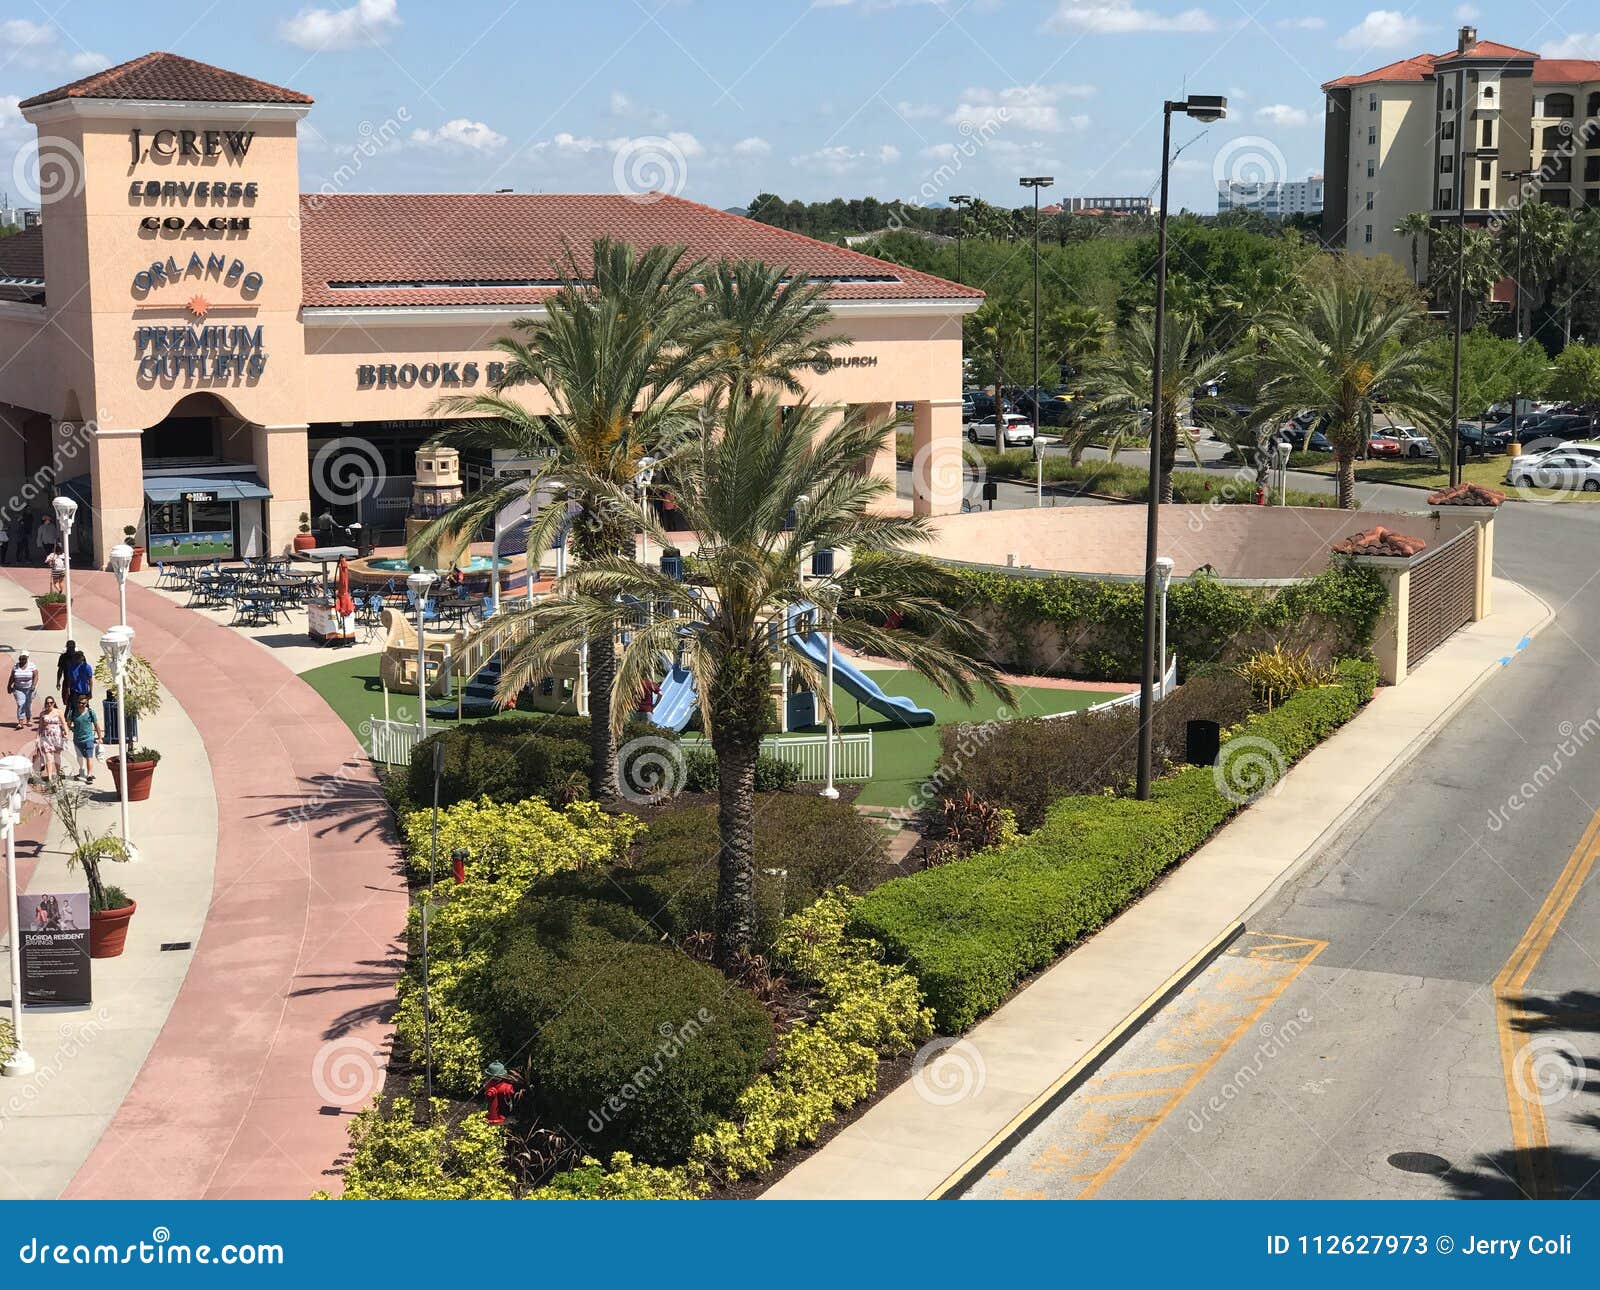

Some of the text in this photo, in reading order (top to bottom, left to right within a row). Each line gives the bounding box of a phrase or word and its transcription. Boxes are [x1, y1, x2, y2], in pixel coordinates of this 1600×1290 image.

[130, 128, 256, 166] J.CREW
[130, 181, 258, 198] CONVERSE
[141, 216, 251, 230] COACH
[134, 251, 264, 290] ORLANDO
[136, 325, 265, 350] PREMIUM
[139, 353, 265, 379] OUTLETS
[358, 362, 479, 386] BROOKS
[834, 356, 878, 368] BURCH
